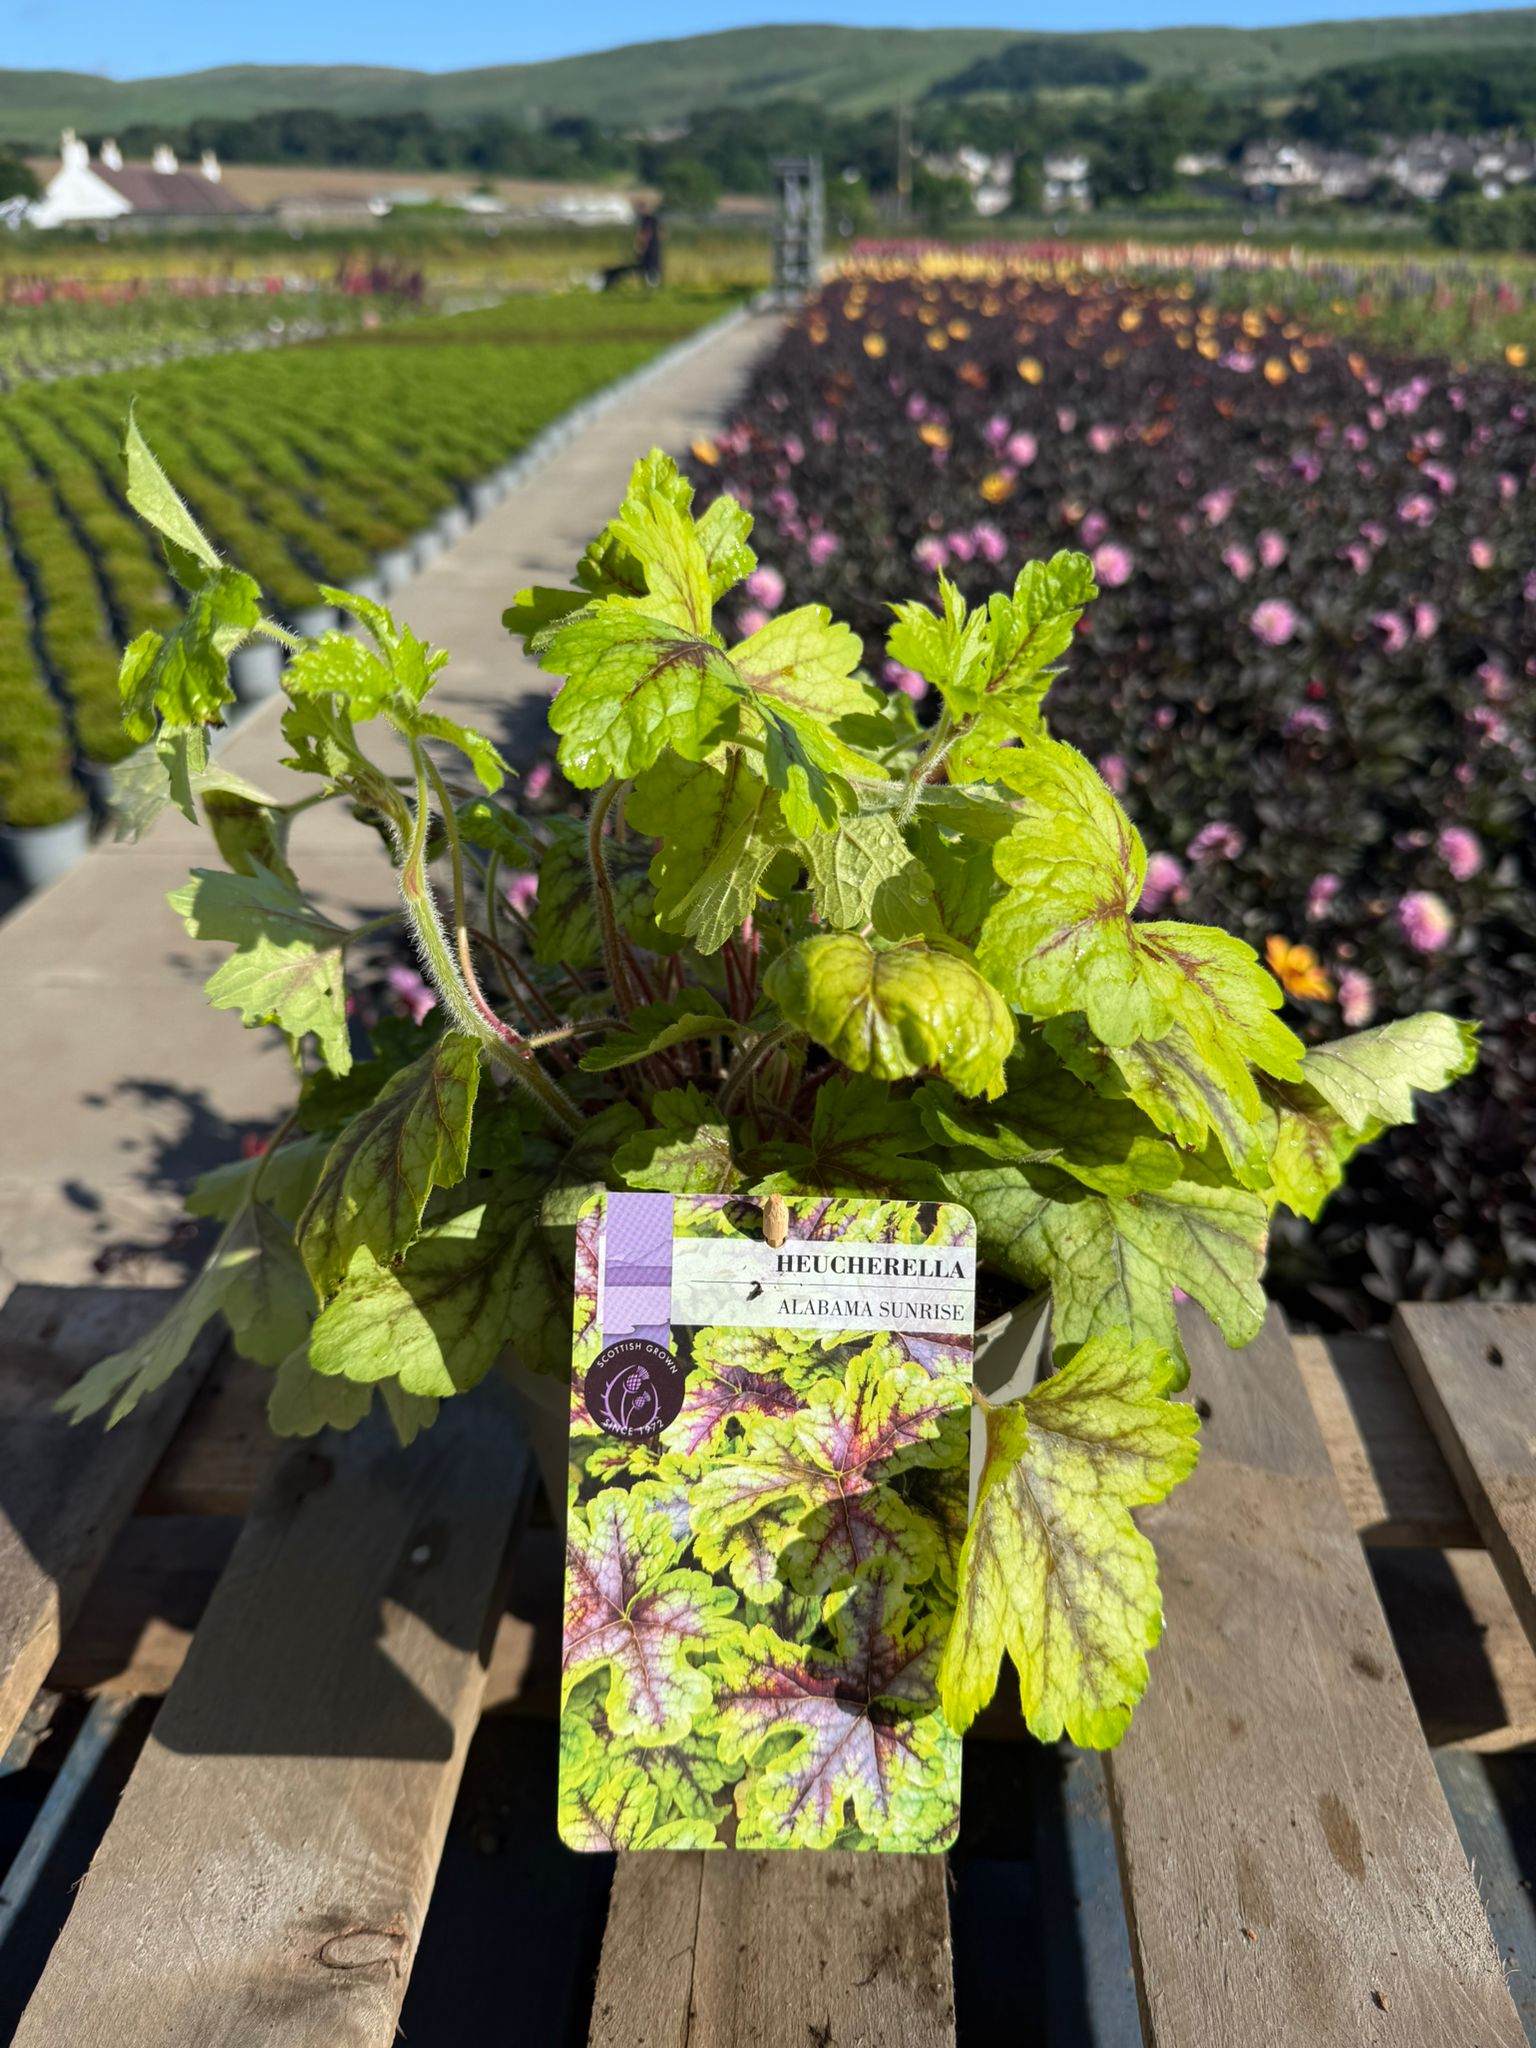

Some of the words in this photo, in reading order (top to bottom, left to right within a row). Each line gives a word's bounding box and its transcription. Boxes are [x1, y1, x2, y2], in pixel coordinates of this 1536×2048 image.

[776, 1254, 966, 1279] HEUCHERELLA
[778, 1299, 873, 1317] ALABAMA
[879, 1301, 965, 1321] SUNRISE
[597, 1342, 642, 1368] SCOTTISH
[646, 1344, 678, 1374] GROWN
[602, 1418, 633, 1436] SINCE
[639, 1419, 665, 1436] 1972
